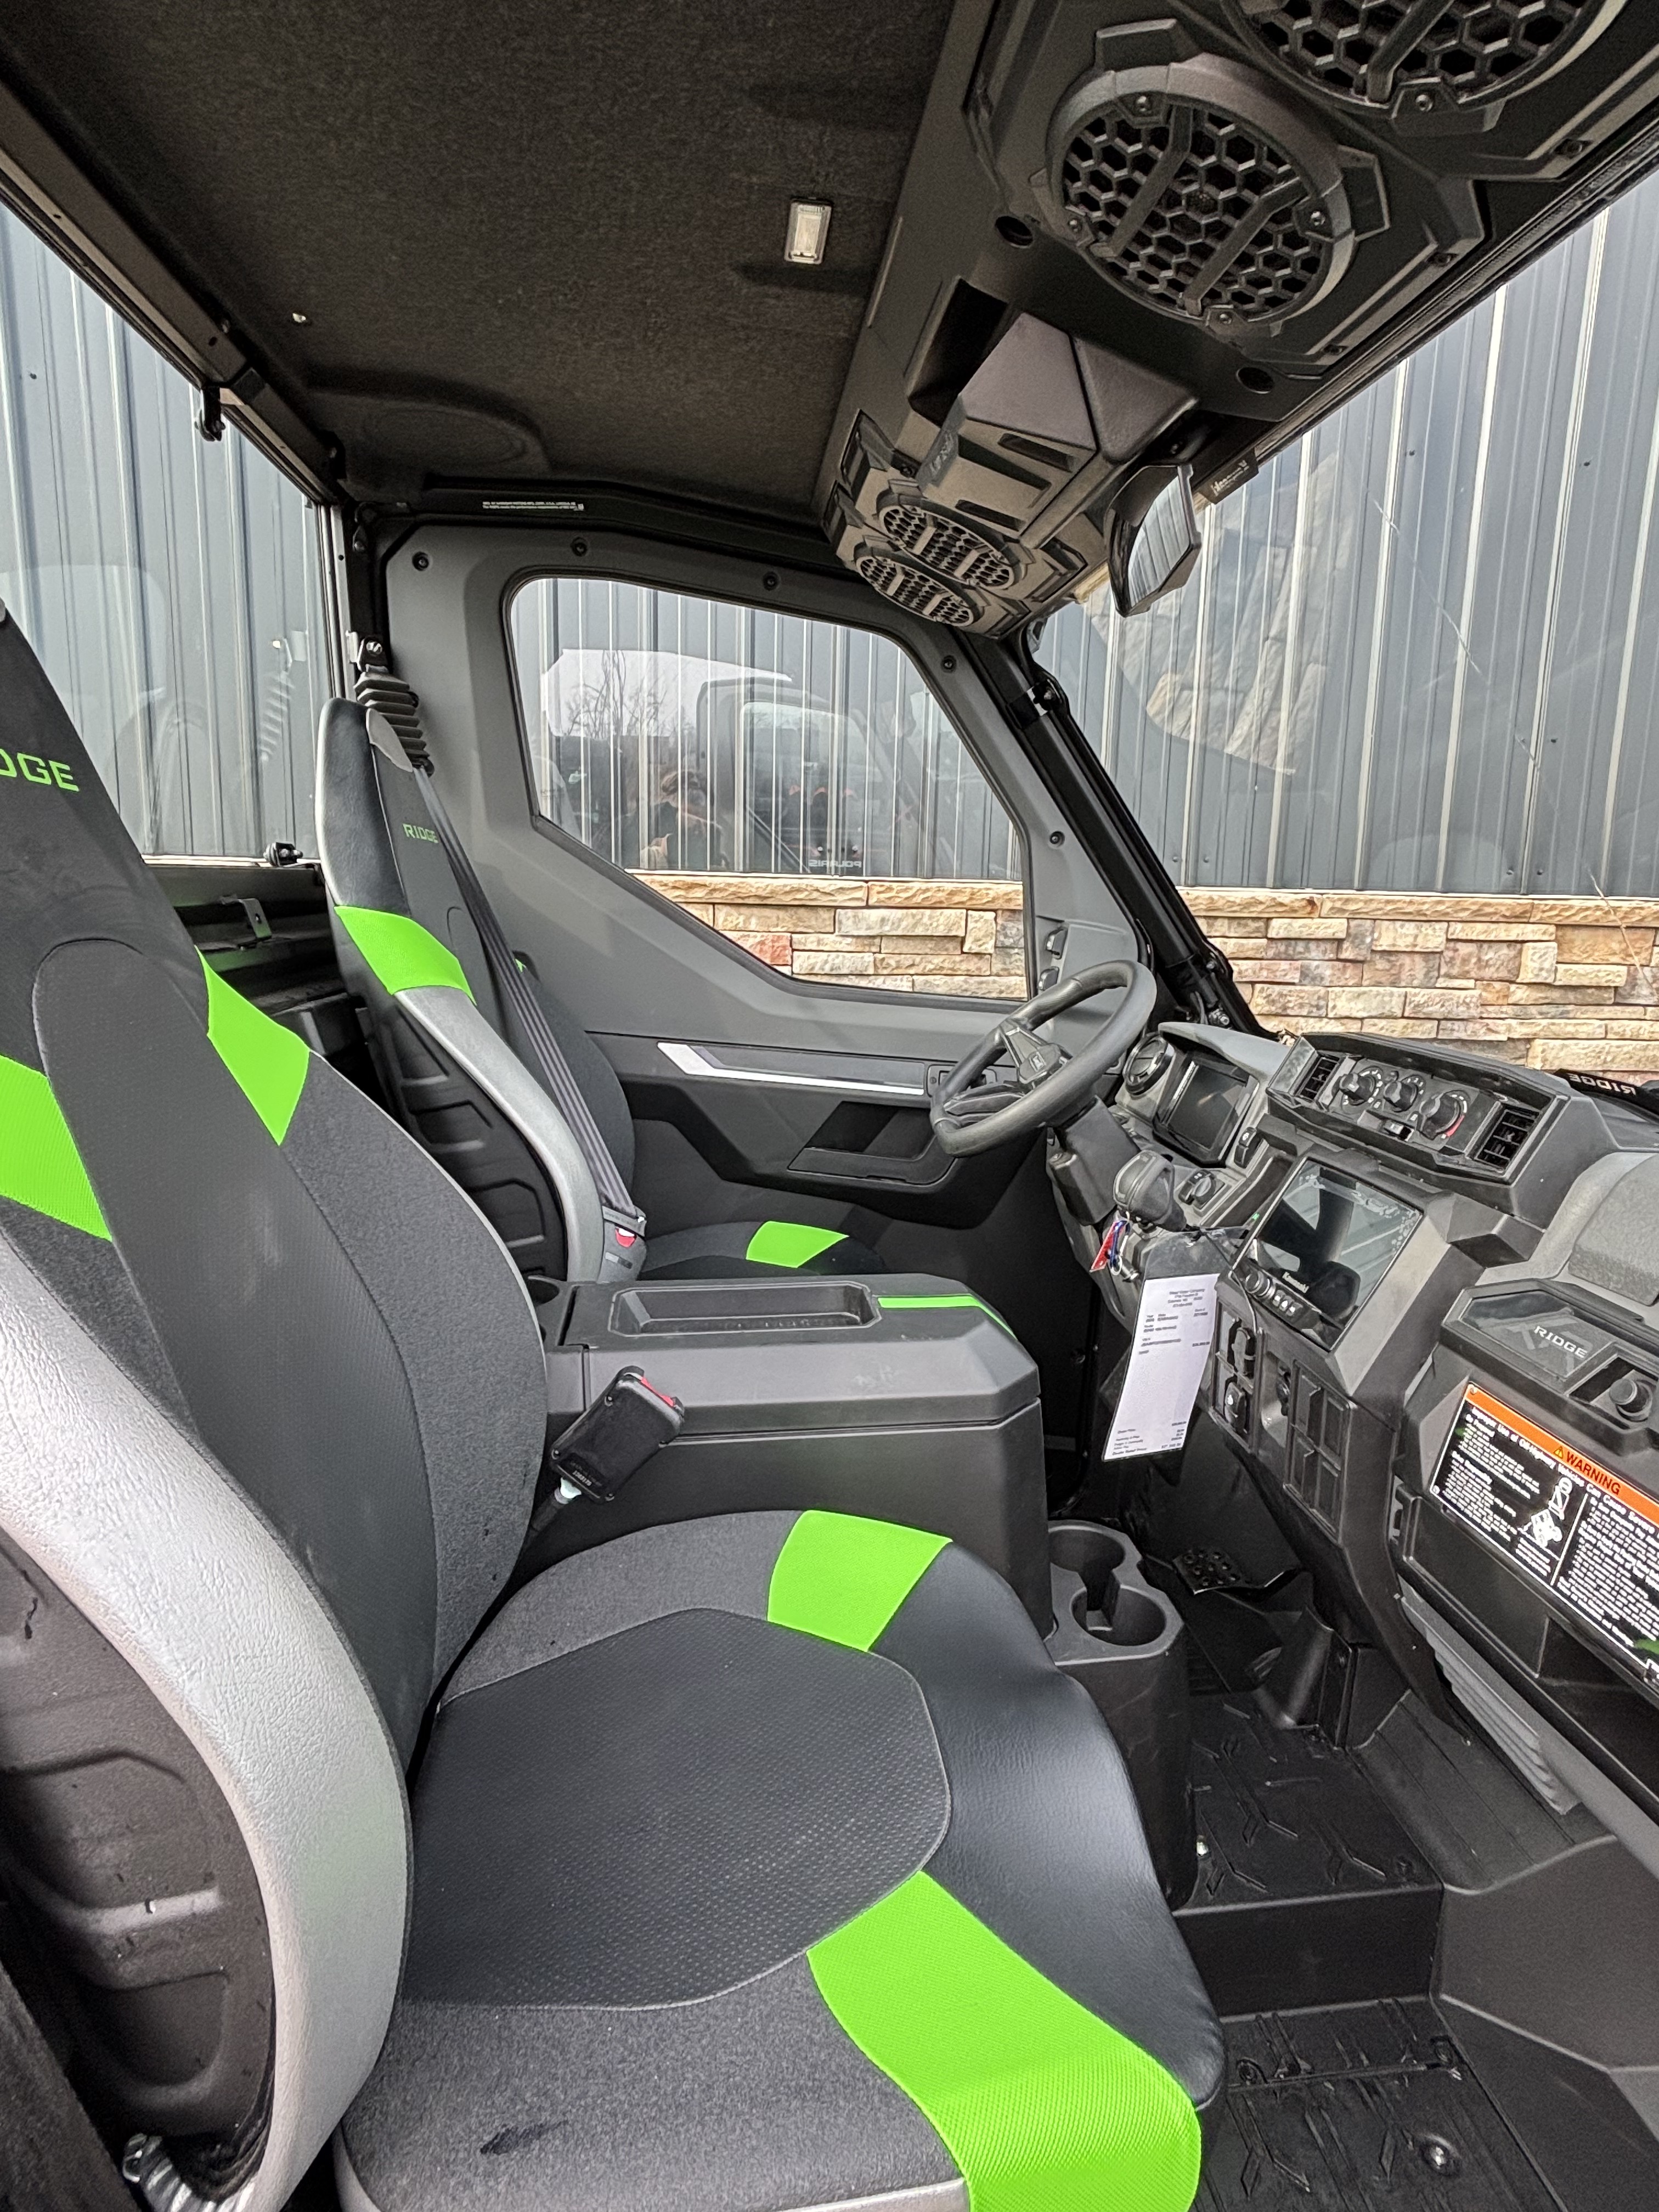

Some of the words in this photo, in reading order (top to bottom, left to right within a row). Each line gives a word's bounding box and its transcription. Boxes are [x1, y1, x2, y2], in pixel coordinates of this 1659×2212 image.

[403, 823, 438, 843] RIDGE
[1534, 1325, 1588, 1359] RIDGE
[1566, 1451, 1621, 1496] WARNING
[1586, 1483, 1601, 1499] Can
[1603, 1494, 1626, 1515] Cause
